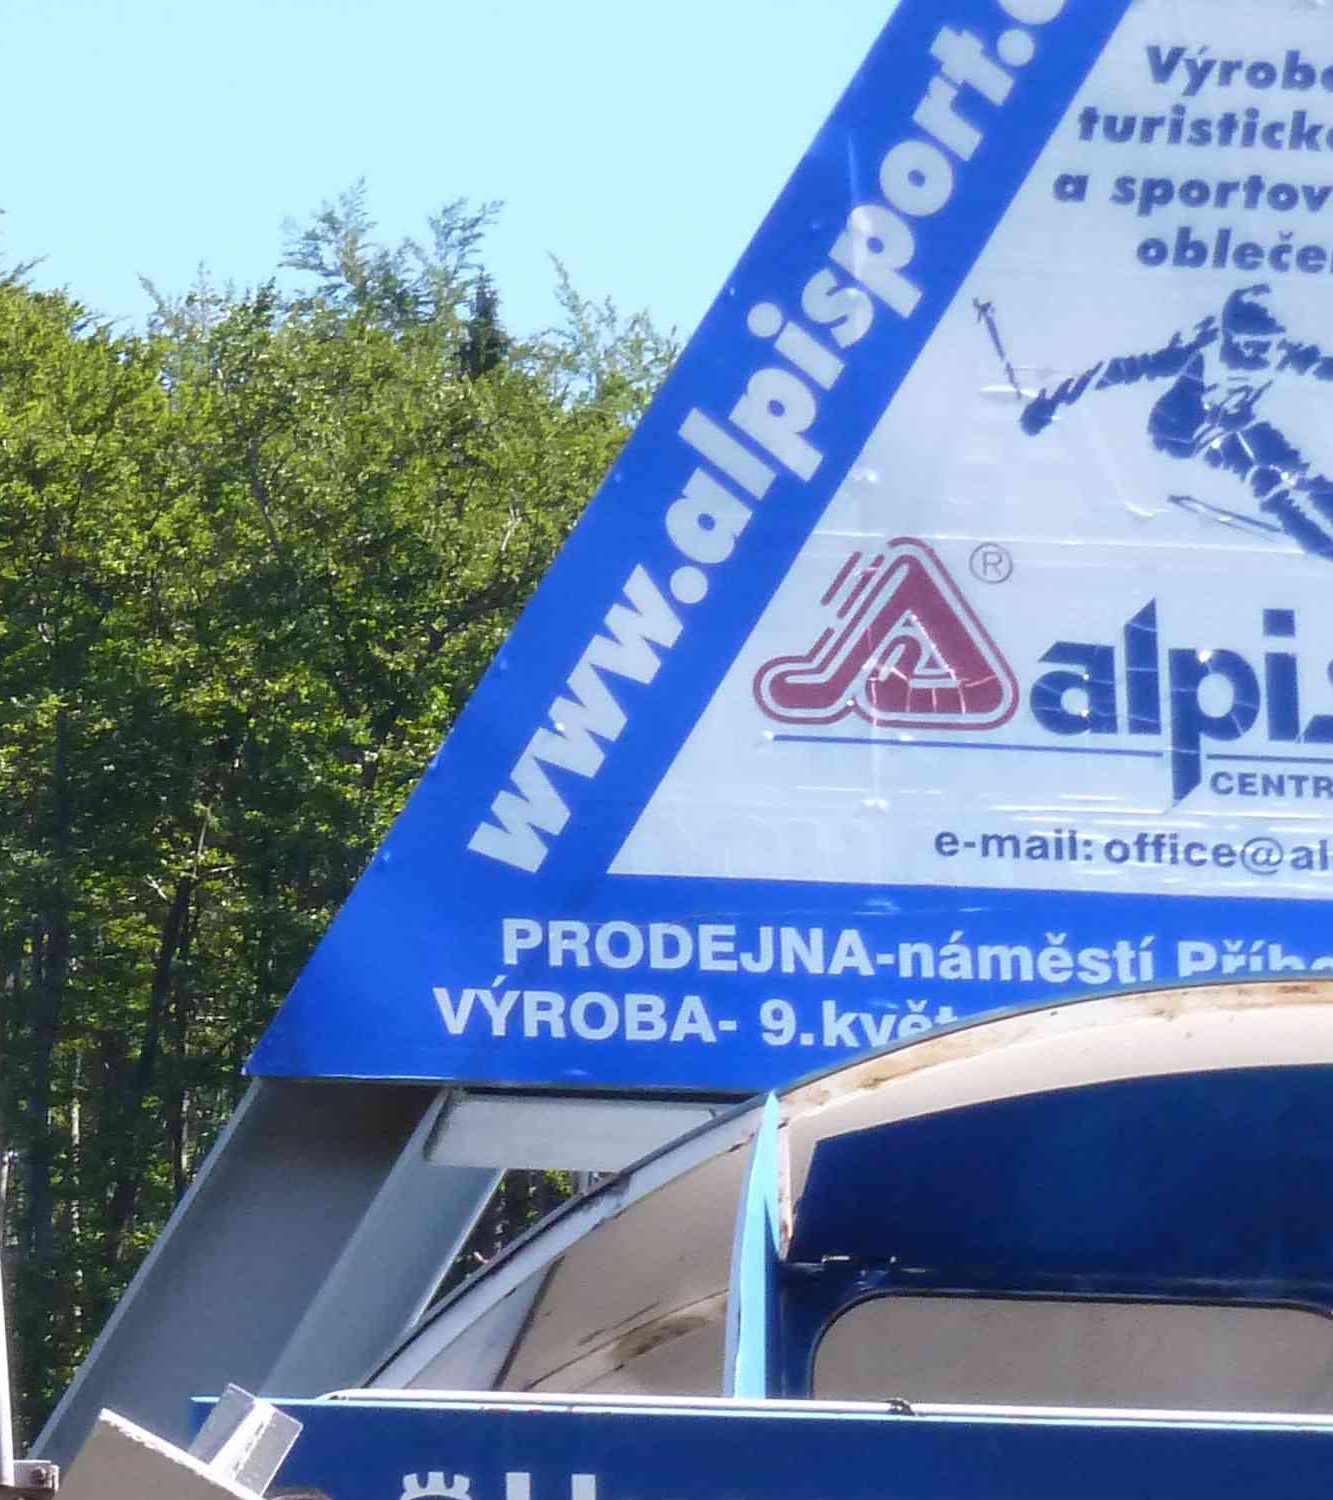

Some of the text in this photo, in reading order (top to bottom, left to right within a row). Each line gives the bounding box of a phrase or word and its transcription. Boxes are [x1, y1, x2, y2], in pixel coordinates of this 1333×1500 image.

[1053, 173, 1333, 216] a sportov
[1136, 225, 1333, 273] obleče
[934, 829, 1328, 876] e-mail: office@al
[502, 918, 1155, 985] PRODEJNA-náměstí
[433, 975, 737, 1043] VÝROBA-
